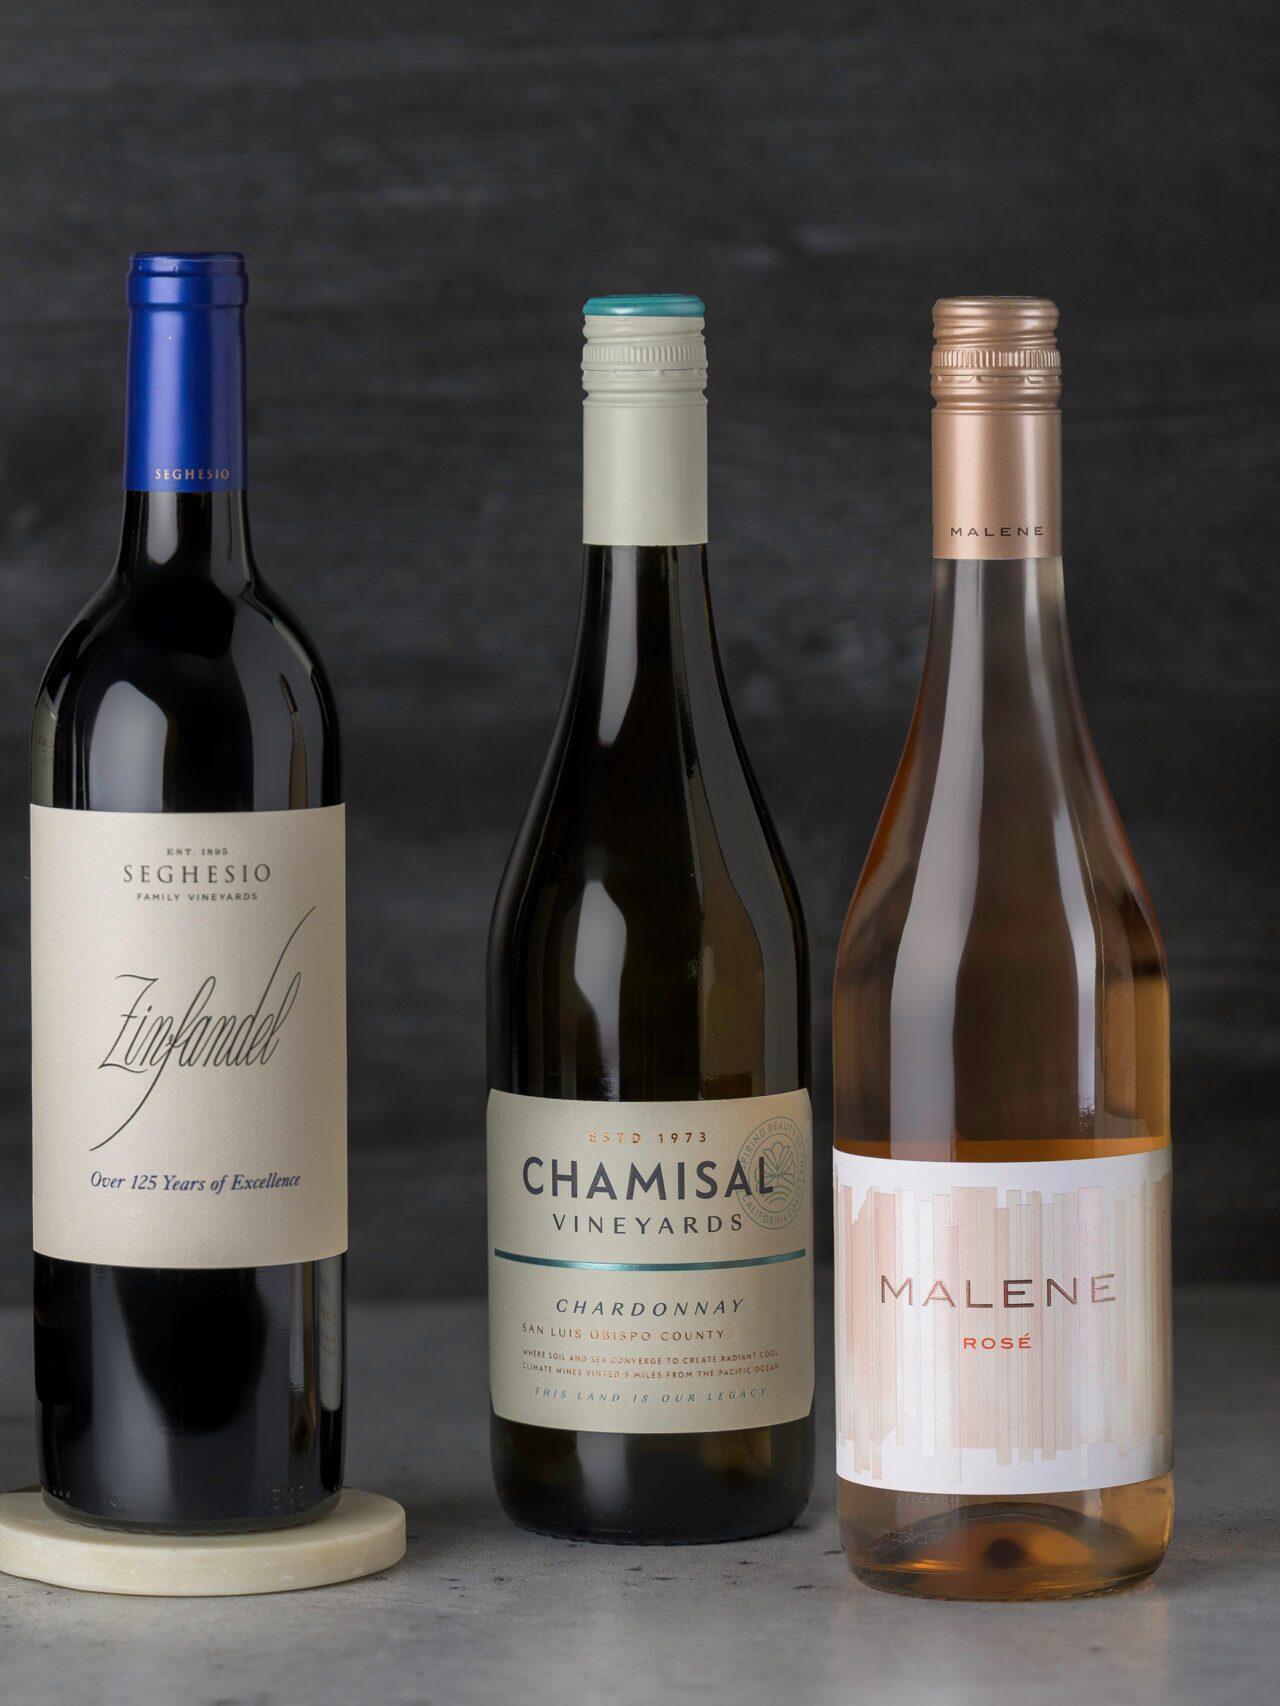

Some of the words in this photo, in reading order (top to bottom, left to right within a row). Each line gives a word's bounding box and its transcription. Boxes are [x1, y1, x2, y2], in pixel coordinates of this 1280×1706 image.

[155, 468, 230, 480] SEGHESIO
[950, 526, 1044, 537] MALENE
[123, 863, 272, 884] SEGHESIO
[136, 893, 180, 901] FAMILY
[188, 892, 259, 901] VINEYARDS
[90, 906, 315, 1152] Zinfandel
[589, 1131, 641, 1144] ESTD
[658, 1131, 706, 1144] 1973
[90, 1171, 126, 1189] Over
[130, 1174, 158, 1191] 125
[162, 1174, 205, 1191] Years
[210, 1174, 228, 1195] of
[230, 1172, 301, 1191] Excellence
[522, 1156, 774, 1200] CHAMISAL
[552, 1213, 742, 1235] VINEYARDS
[881, 1273, 1116, 1309] MALENE
[556, 1298, 744, 1317] CHARDONNAY
[522, 1322, 544, 1334] SAN
[551, 1327, 582, 1339] LUIS
[590, 1330, 651, 1341] OBISPO
[660, 1330, 724, 1341] COUNTY
[963, 1332, 1032, 1349] ROSÉ
[522, 1349, 545, 1359] WHERE
[548, 1352, 566, 1361] SOIL
[569, 1354, 587, 1363] AND
[591, 1356, 607, 1364] SEA
[610, 1357, 662, 1365] CONVERGE
[667, 1357, 679, 1365] TO
[683, 1355, 717, 1364] CREATE
[721, 1352, 757, 1362] RADIANT
[522, 1362, 552, 1373] CLIMATE
[555, 1367, 582, 1376] WINES
[586, 1369, 620, 1378] VINTED
[633, 1371, 662, 1379] MILES
[666, 1371, 693, 1379] FROM
[719, 1366, 751, 1376] PACIFIC
[754, 1362, 779, 1373] OCEAN
[535, 1386, 567, 1399] THIS
[577, 1391, 620, 1402] LAND
[633, 1394, 649, 1403] IS
[661, 1393, 696, 1403] OUR
[707, 1386, 767, 1401] LEGACY
